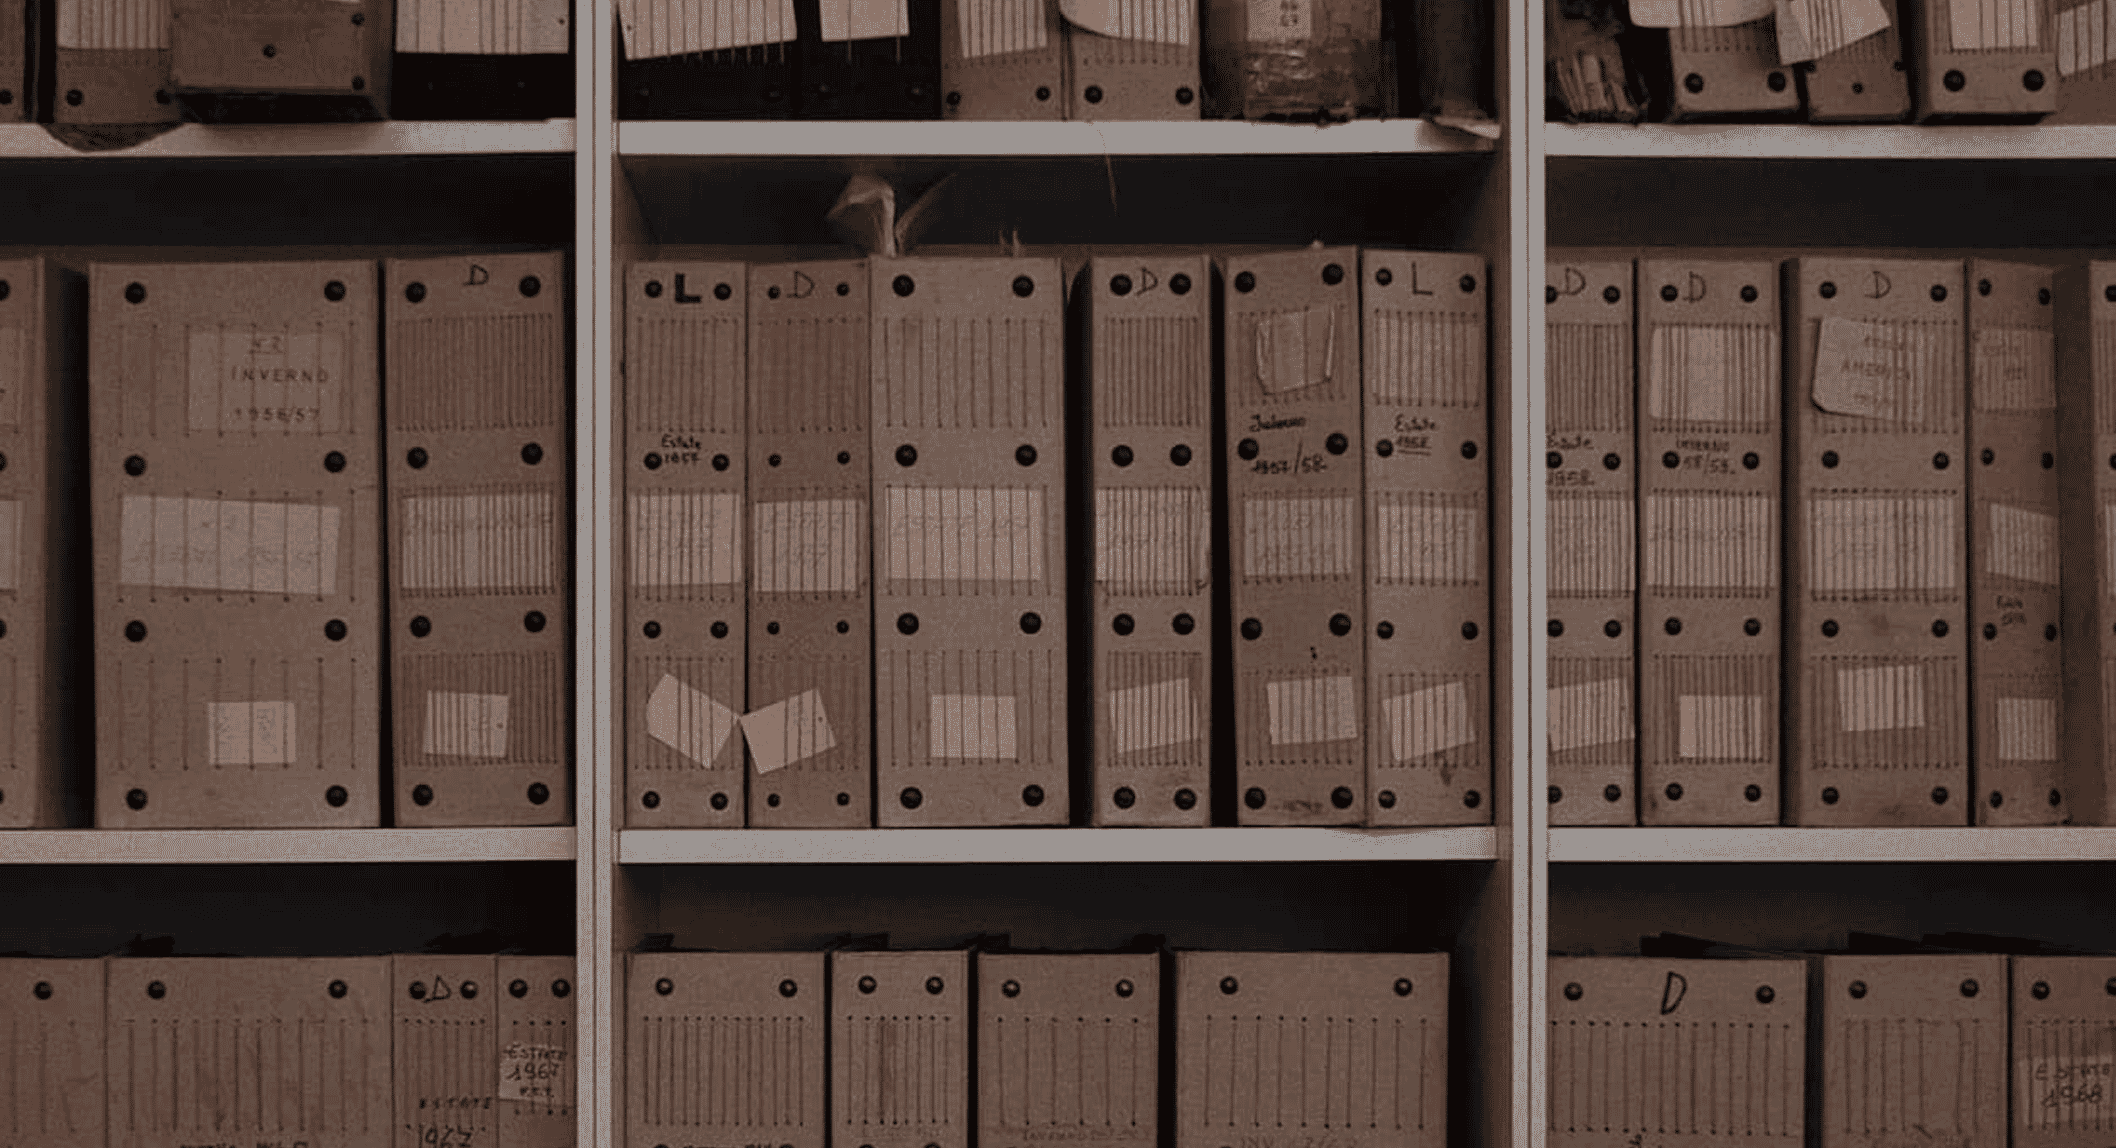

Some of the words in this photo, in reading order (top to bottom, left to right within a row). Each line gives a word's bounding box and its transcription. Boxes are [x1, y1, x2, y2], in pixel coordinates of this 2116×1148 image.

[462, 263, 489, 287] D
[674, 273, 702, 303] L
[787, 270, 815, 299] D
[1137, 267, 1158, 296] D
[1412, 261, 1433, 295] L
[1556, 267, 1587, 297] D
[1682, 270, 1706, 304] D
[1864, 270, 1892, 300] D
[231, 365, 329, 383] INVERNO
[424, 974, 452, 1004] D
[1660, 971, 1689, 1016] D
